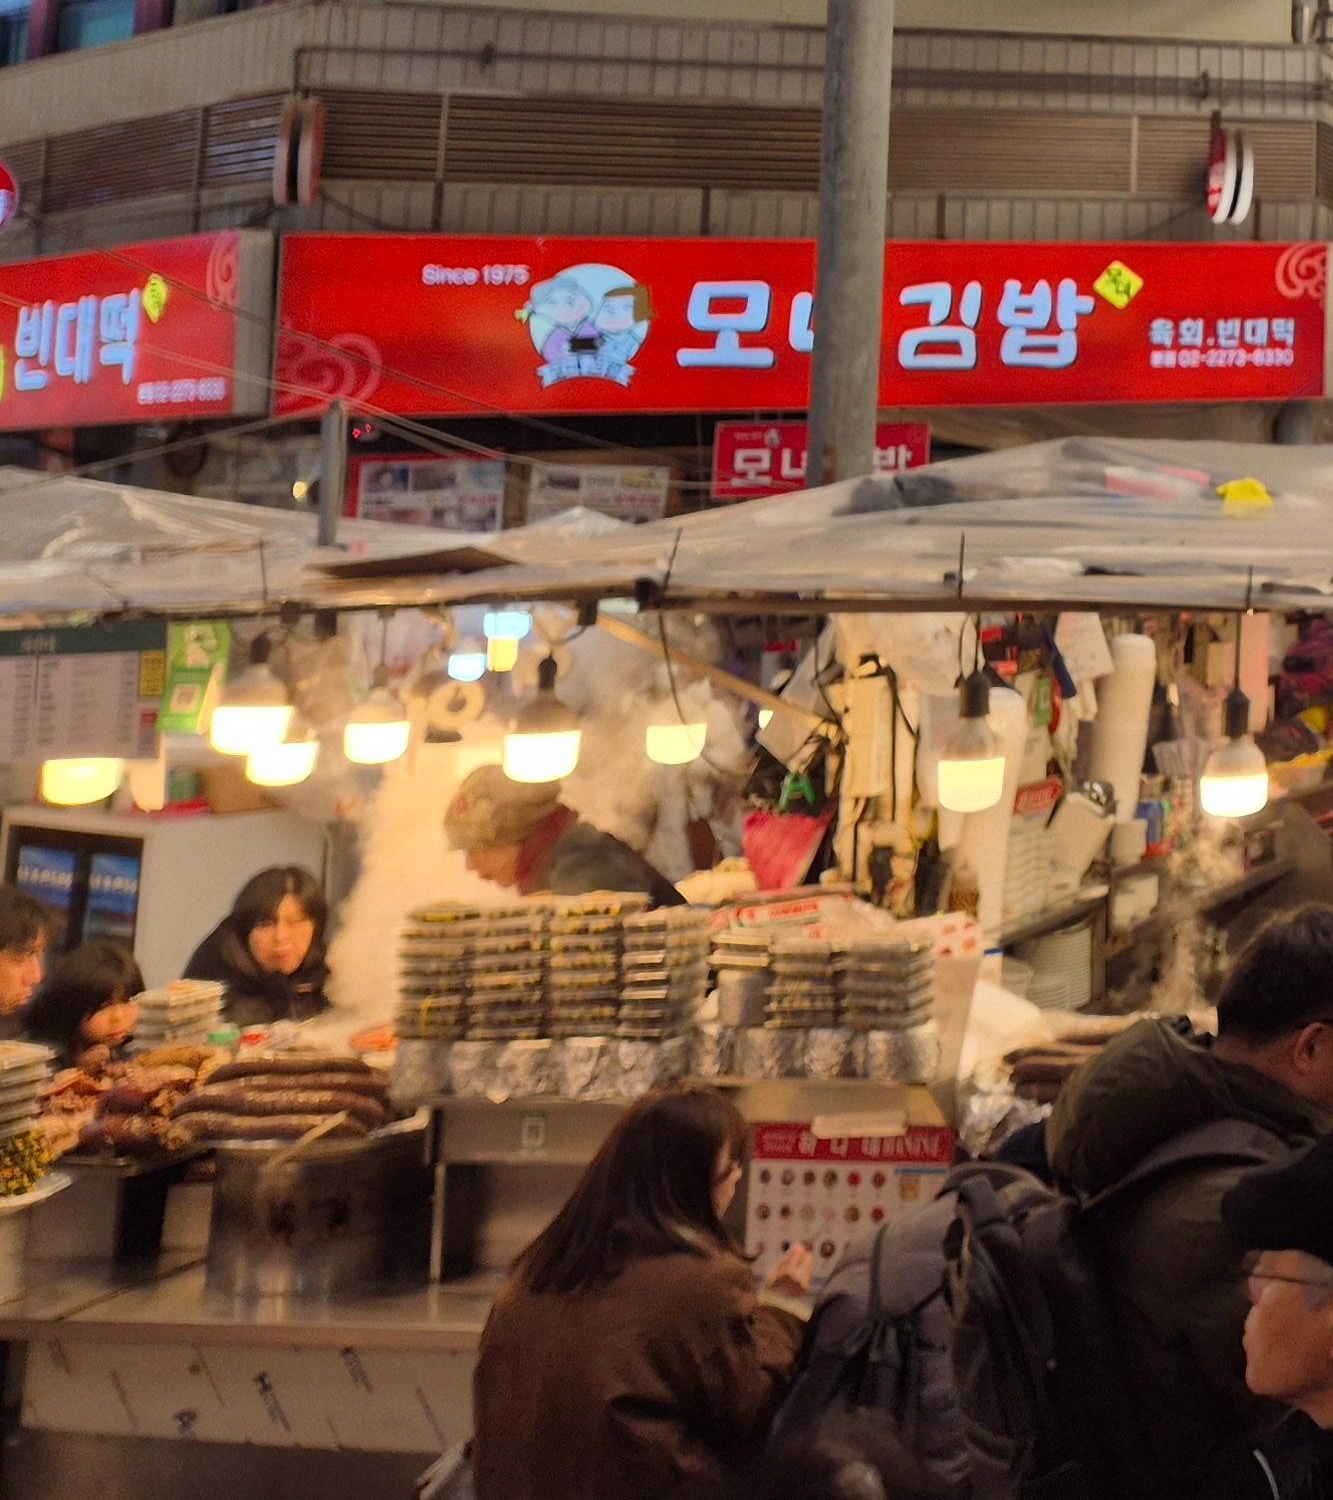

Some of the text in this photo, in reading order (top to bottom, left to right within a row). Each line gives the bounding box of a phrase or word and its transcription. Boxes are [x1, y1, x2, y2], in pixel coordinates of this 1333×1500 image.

[422, 264, 478, 286] Since
[14, 287, 141, 392] 빈대떡
[676, 277, 1094, 370] 모김밥
